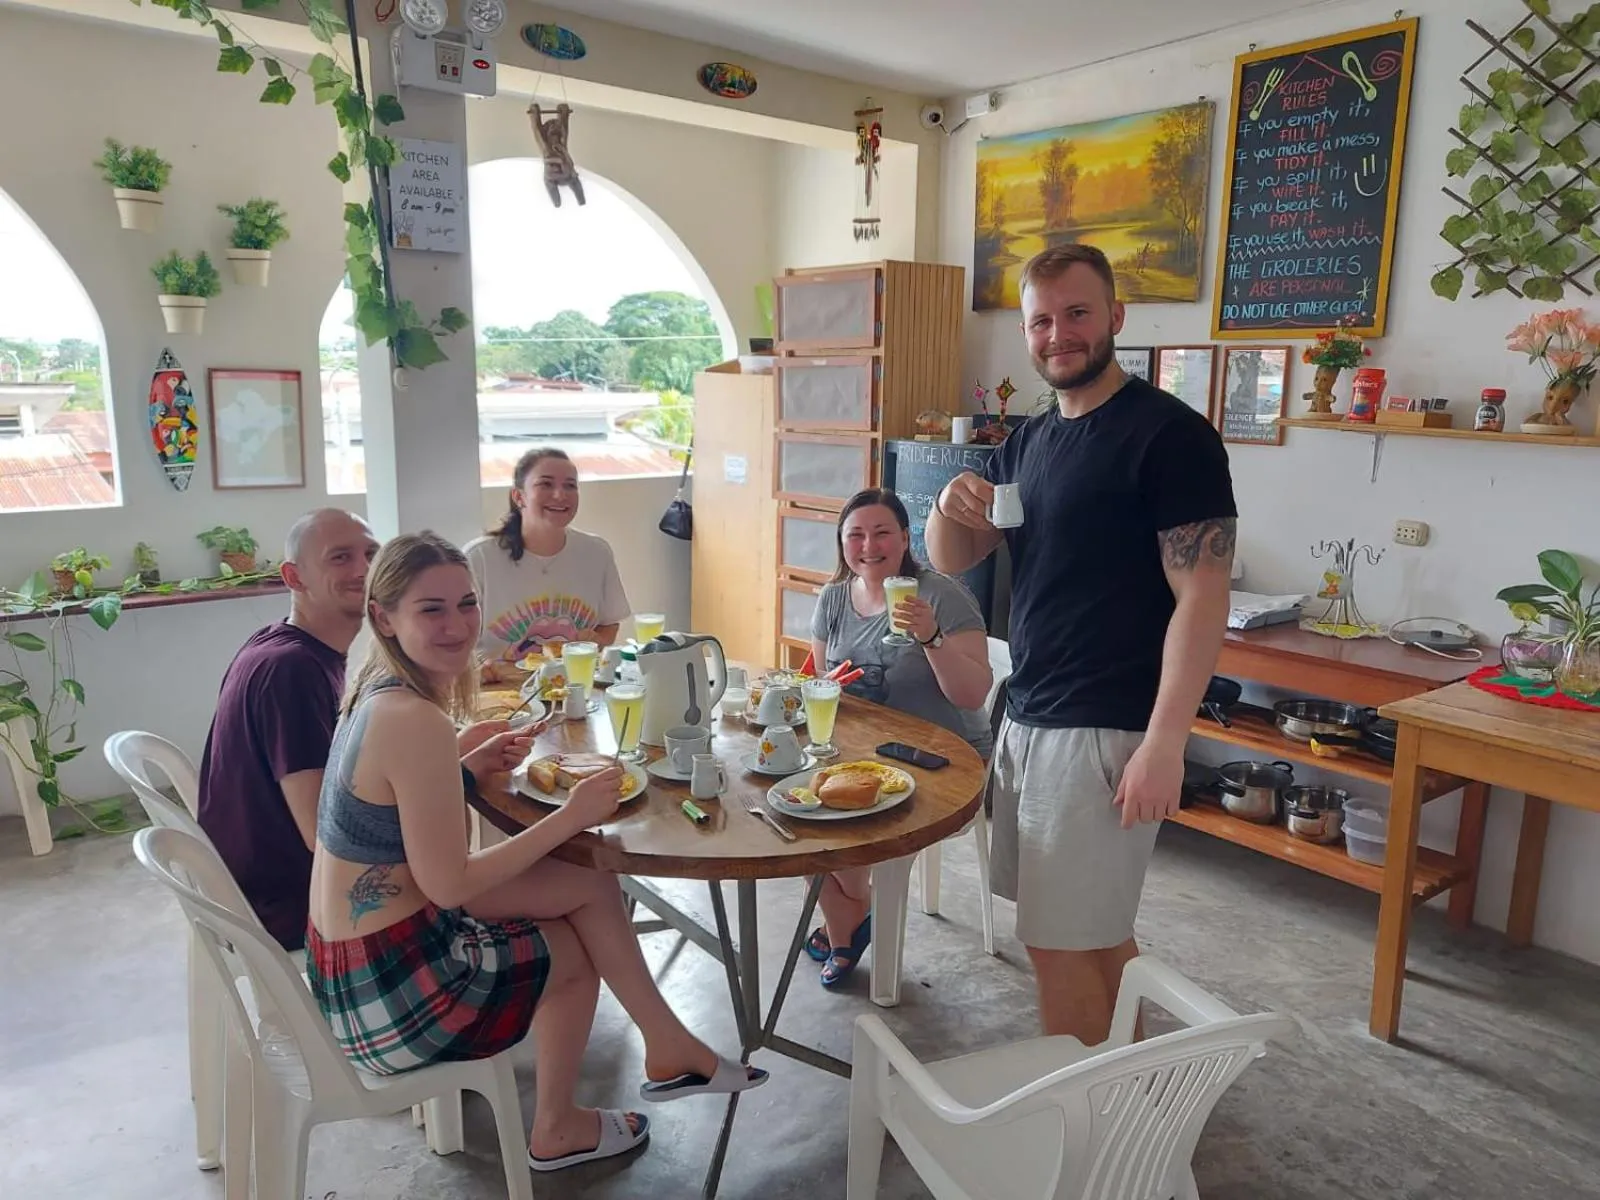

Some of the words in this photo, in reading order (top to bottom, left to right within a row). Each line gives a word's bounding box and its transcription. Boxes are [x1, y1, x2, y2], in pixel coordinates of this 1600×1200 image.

[1279, 75, 1335, 96] KITCHEN
[1282, 93, 1327, 111] RULES
[1258, 119, 1282, 138] you
[1287, 106, 1339, 130] empty
[1280, 127, 1307, 143] FILL
[400, 151, 449, 167] KITCHEN
[1253, 147, 1276, 164] you
[1278, 142, 1319, 157] make
[1322, 139, 1331, 151] a
[1275, 155, 1309, 171] TIDY
[411, 169, 440, 181] AREA
[1257, 175, 1280, 193] you
[1287, 168, 1321, 188] spill
[399, 185, 454, 200] AVAILABLE
[1272, 184, 1305, 198] WIPE
[401, 199, 409, 210] 8
[1250, 203, 1272, 219] you
[1276, 198, 1324, 213] break
[1270, 212, 1299, 229] PAY
[1244, 235, 1265, 254] you
[1266, 231, 1289, 245] use
[1229, 263, 1250, 280] THE
[1261, 254, 1362, 279] GROCERIES
[1249, 280, 1277, 297] ARE
[1223, 304, 1239, 320] DO
[1241, 302, 1270, 319] NOT
[1270, 302, 1292, 318] USE
[1294, 300, 1328, 317] OTHER
